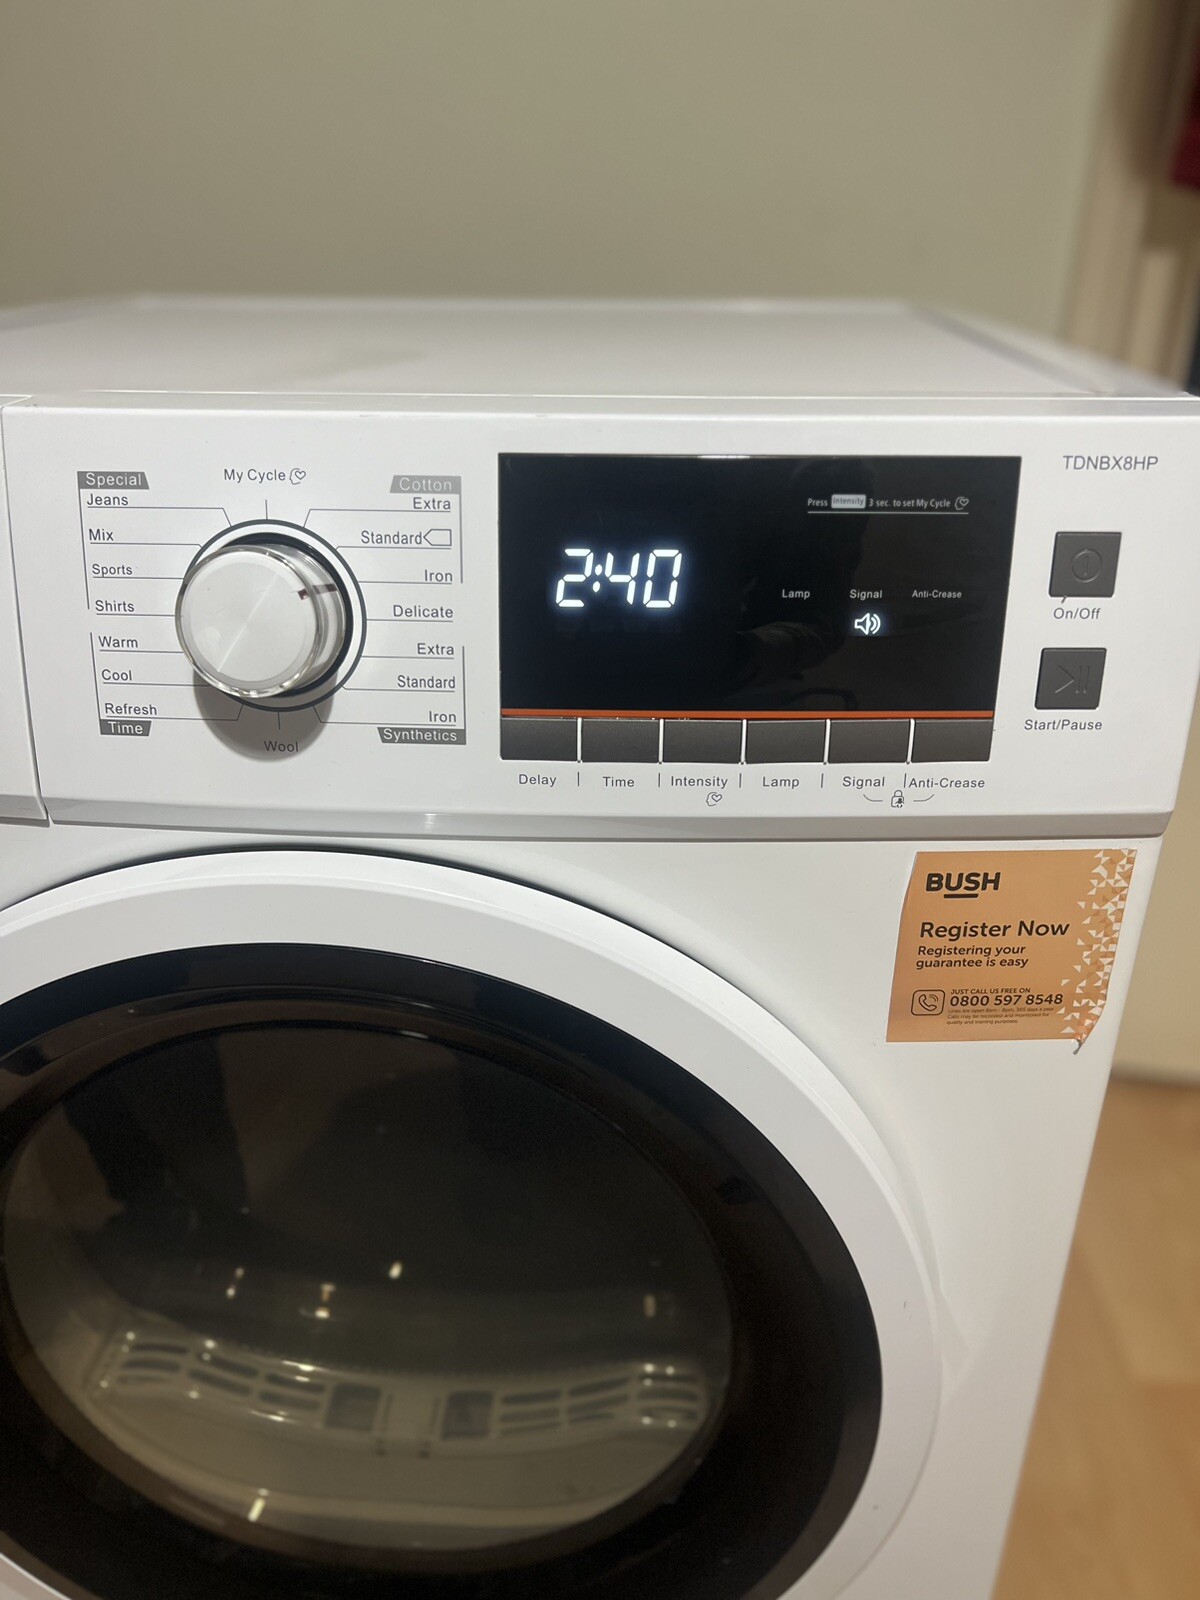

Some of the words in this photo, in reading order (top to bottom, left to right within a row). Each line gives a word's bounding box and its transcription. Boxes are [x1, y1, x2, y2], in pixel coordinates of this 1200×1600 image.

[1063, 456, 1158, 470] TDNBX8HP
[86, 472, 142, 488] Special
[224, 469, 243, 484] My
[248, 468, 286, 484] Cycle
[399, 478, 452, 492] Cotton
[87, 494, 128, 506] Jeans
[413, 497, 451, 510] Extra
[807, 498, 828, 507] Press
[832, 496, 864, 507] Intensity
[868, 499, 874, 507] 3
[893, 499, 901, 507] to
[903, 499, 915, 507] set
[916, 499, 928, 509] My
[929, 499, 951, 509] Cycle
[88, 530, 114, 541] Mix
[361, 531, 423, 545] Standard
[92, 564, 132, 577] Sports
[424, 570, 453, 582] Iron
[556, 548, 682, 608] 2:40
[782, 589, 811, 600] Lamp
[850, 589, 883, 601] Signal
[912, 590, 962, 599] Anti-Crease
[96, 600, 134, 612] Shirts
[393, 605, 454, 618] Delicate
[1053, 607, 1101, 620] On/Off
[98, 636, 138, 648] Warm
[417, 643, 455, 656] Extra
[102, 669, 132, 681] Cool
[397, 675, 456, 689] Standard
[105, 703, 158, 715] Refresh
[429, 711, 457, 723] Iron
[108, 721, 143, 735] Time
[1024, 719, 1103, 731] Start/Pause
[383, 728, 458, 742] Synthetics
[264, 740, 299, 752] Wool
[518, 774, 558, 788] Delay
[602, 776, 635, 788] Time
[670, 775, 729, 790] Intensity
[762, 776, 800, 790] Lamp
[842, 775, 886, 790] Signal
[909, 778, 986, 788] Anti-Crease
[926, 872, 1001, 892] BUSH
[920, 922, 1012, 942] Register
[1018, 920, 1070, 936] Now
[918, 945, 992, 959] Registering
[994, 945, 1026, 957] your
[916, 958, 983, 970] guarantee
[986, 957, 996, 967] is
[999, 958, 1029, 969] easy
[950, 996, 990, 1006] 0800
[994, 994, 1022, 1006] 597
[1025, 994, 1064, 1005] 8548
